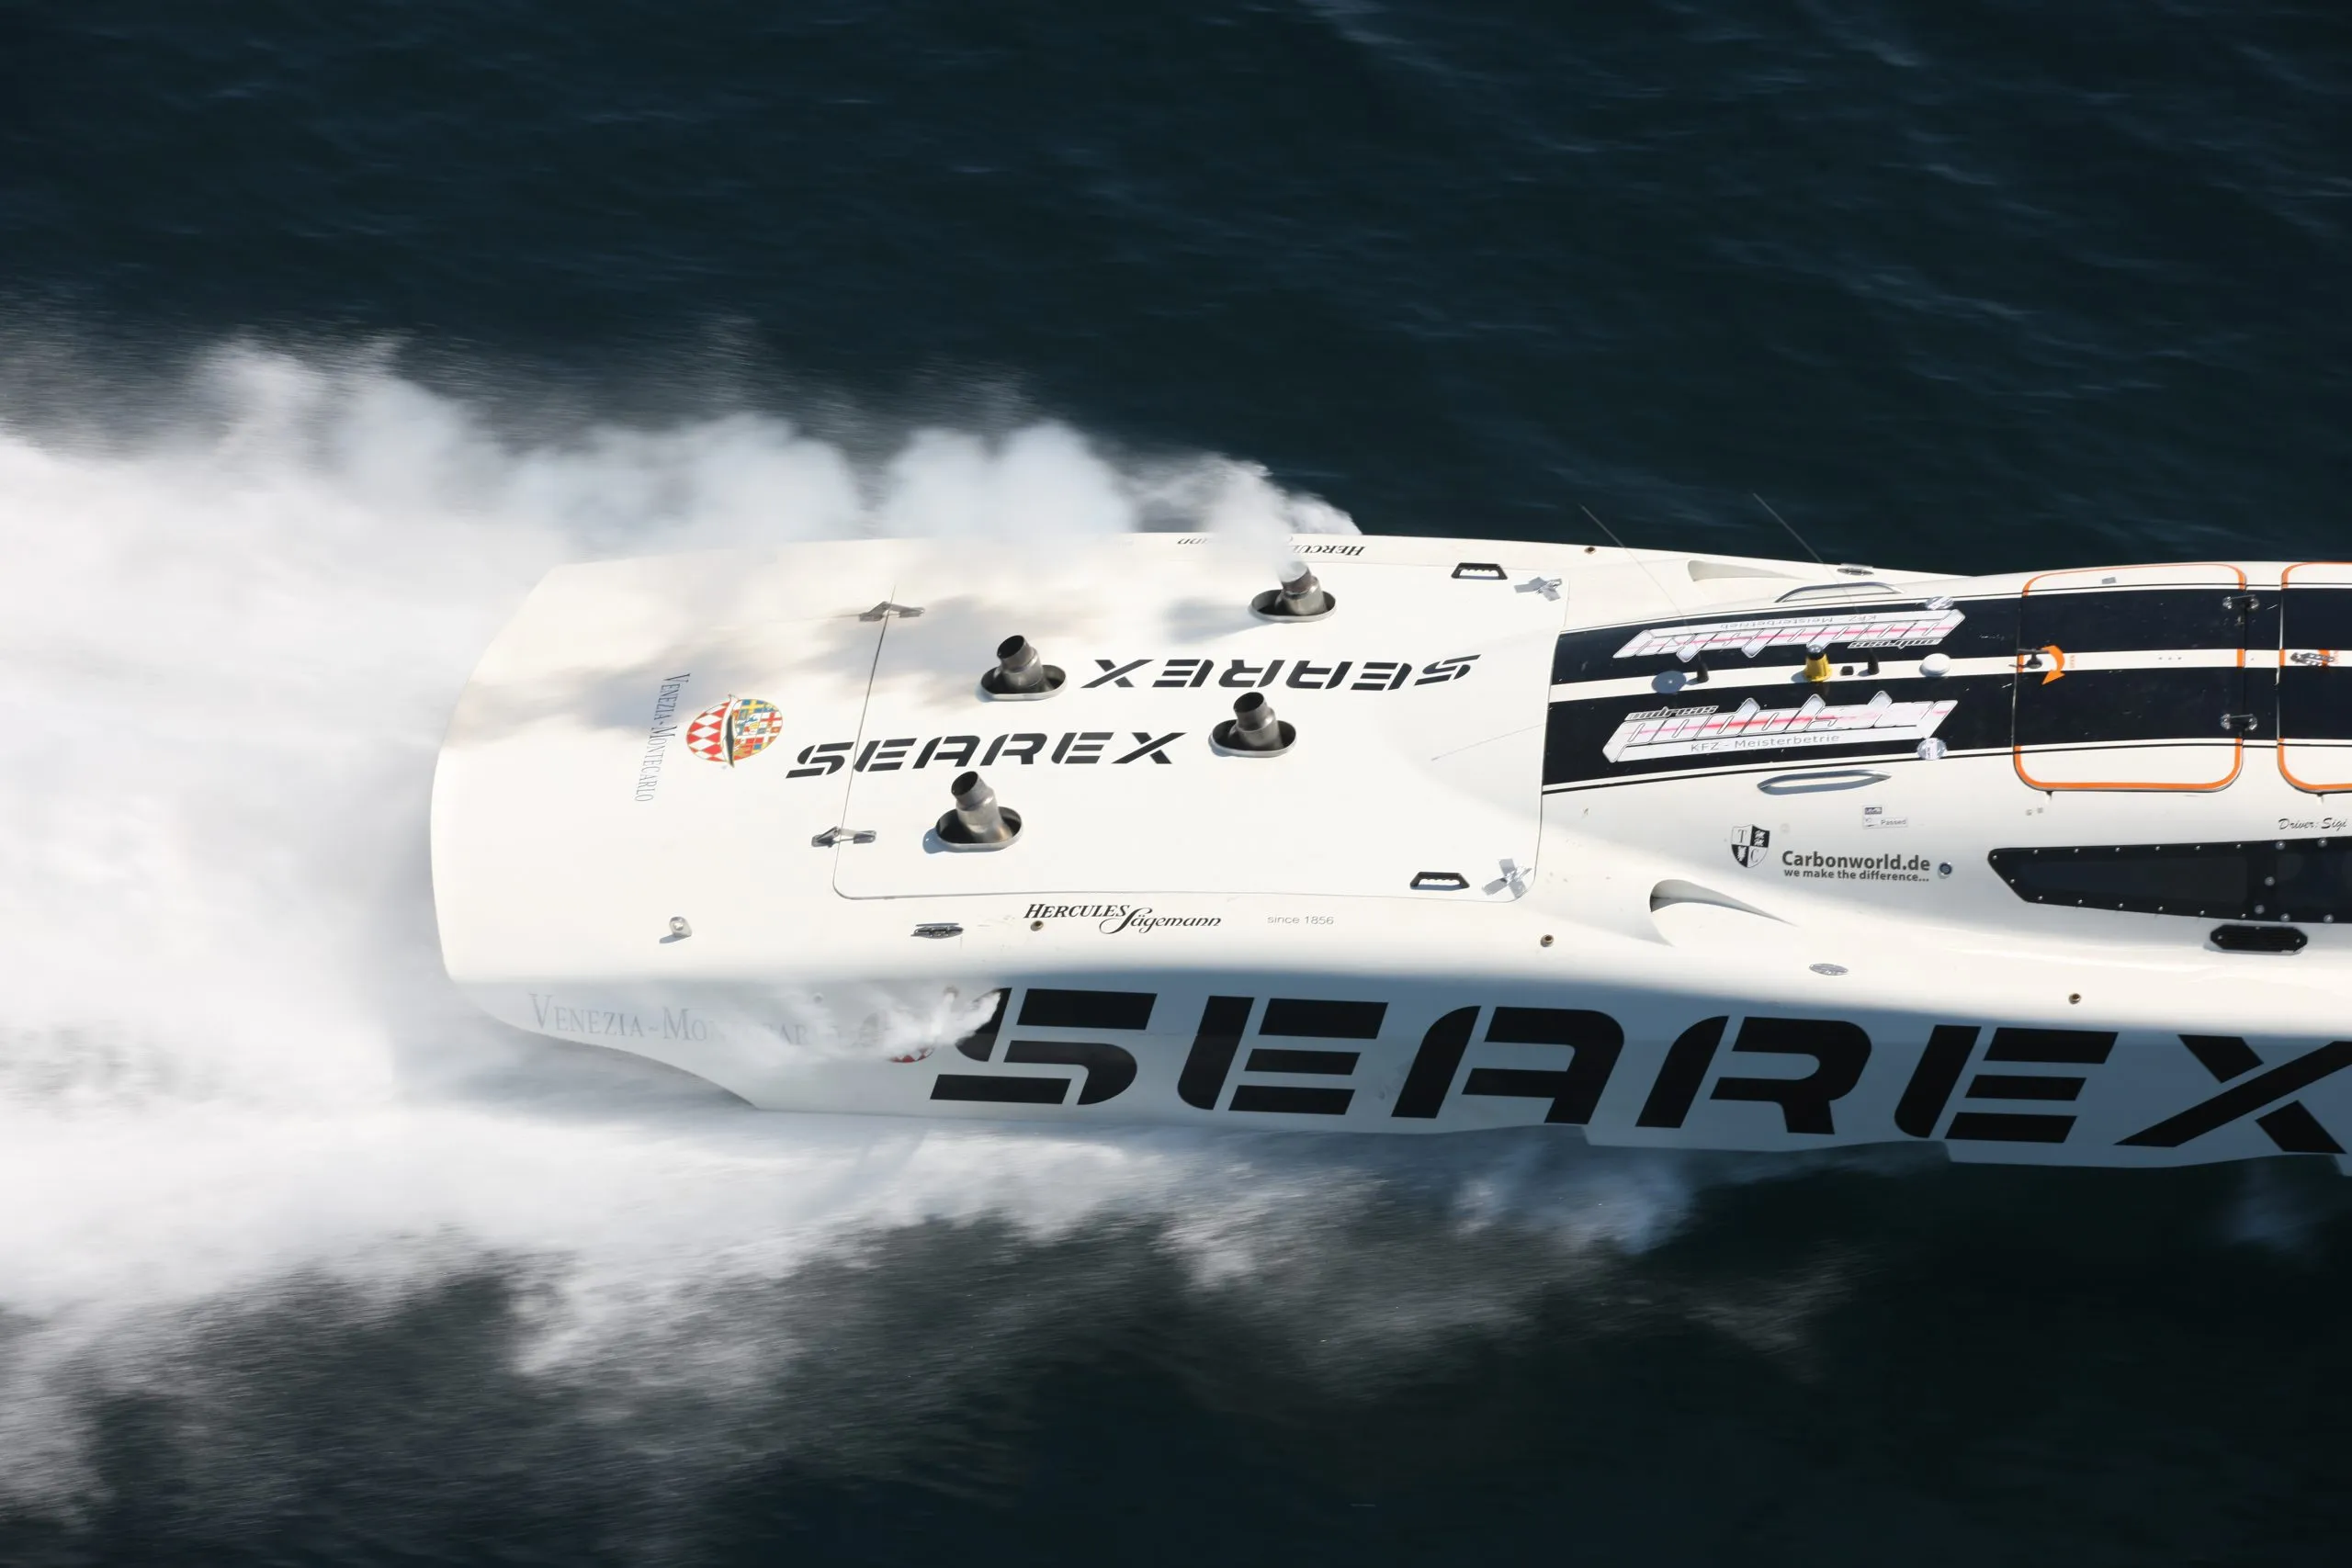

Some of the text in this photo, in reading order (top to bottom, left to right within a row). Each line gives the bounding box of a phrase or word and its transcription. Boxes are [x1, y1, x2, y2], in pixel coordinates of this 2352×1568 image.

[1080, 653, 1481, 692] SEAREX
[786, 732, 1188, 779] SEAREX
[1690, 742, 1719, 752] KFZ
[1781, 850, 1930, 871] Carbonworld.de
[1803, 868, 1835, 878] make
[1838, 869, 1857, 879] the
[1860, 869, 1929, 882] difference...
[1023, 904, 1221, 934] HERCULES Sägemann
[1267, 915, 1335, 925] since 1856
[930, 987, 2352, 1155] SEAREX
